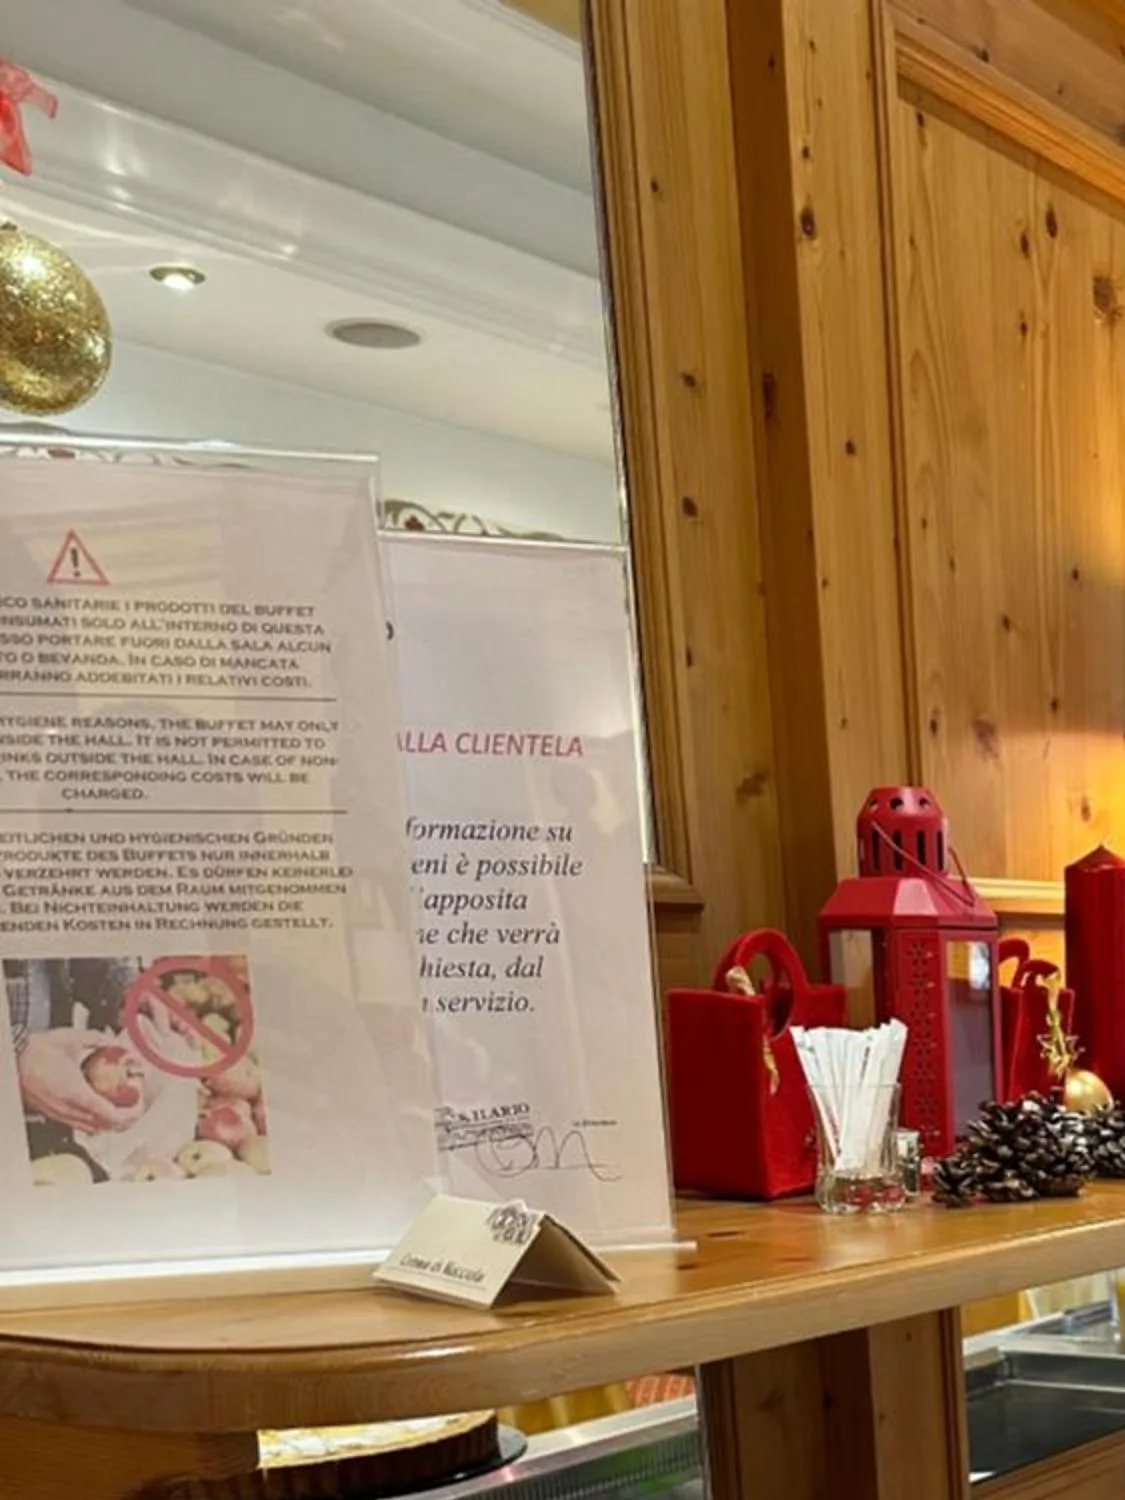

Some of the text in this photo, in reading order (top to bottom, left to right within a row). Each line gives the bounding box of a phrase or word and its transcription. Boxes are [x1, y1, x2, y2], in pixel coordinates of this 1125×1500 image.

[134, 600, 215, 614] PRODOTTI
[220, 602, 250, 616] DEL
[254, 604, 314, 617] BUFFET
[81, 617, 126, 630] SOLO
[241, 621, 258, 634] DI
[261, 622, 324, 636] QUESTA
[38, 634, 116, 647] PORTARE
[120, 636, 170, 649] FUORI
[174, 638, 227, 650] DALLA
[231, 639, 272, 651] SALA
[278, 640, 332, 653] ALCUN
[21, 651, 34, 664] O
[150, 655, 197, 668] CASO
[200, 656, 216, 669] DI
[76, 672, 173, 686] ADDEBITATI
[186, 674, 258, 687] RELATIVI
[158, 718, 192, 731] THE
[195, 718, 257, 731] BUFFET
[260, 720, 294, 732] MAY
[297, 720, 339, 733] ONLY
[47, 734, 80, 747] THE
[136, 733, 152, 748] IT
[155, 735, 171, 748] IS
[174, 735, 208, 749] NOT
[211, 736, 302, 750] PERMITTED
[304, 738, 327, 751] TO
[455, 731, 584, 757] CLIENTELA
[46, 752, 117, 764] OUTSIDE
[120, 753, 153, 765] THE
[207, 753, 226, 767] IN
[228, 754, 273, 768] CASE
[275, 755, 296, 768] OF
[5, 769, 310, 785] THE CORRESPONDING COSTS WILL BE
[405, 816, 574, 843] formazione su
[89, 832, 126, 845] UND
[86, 850, 119, 863] DES
[121, 848, 197, 863] BUFFETS
[200, 849, 235, 862] NUR
[239, 849, 331, 862] INNERHALB
[411, 851, 583, 883] eni è possibile
[100, 885, 134, 897] AUS
[137, 884, 173, 897] DEM
[175, 882, 225, 896] RAUM
[203, 900, 274, 913] WERDEN
[277, 900, 304, 912] DIE
[63, 917, 131, 932] KOSTEN
[134, 918, 152, 931] IN
[154, 917, 249, 931] RECHNUNG
[447, 920, 489, 945] che
[496, 921, 561, 945] verrà
[505, 954, 544, 979] dal
[436, 993, 536, 1014] servizio.
